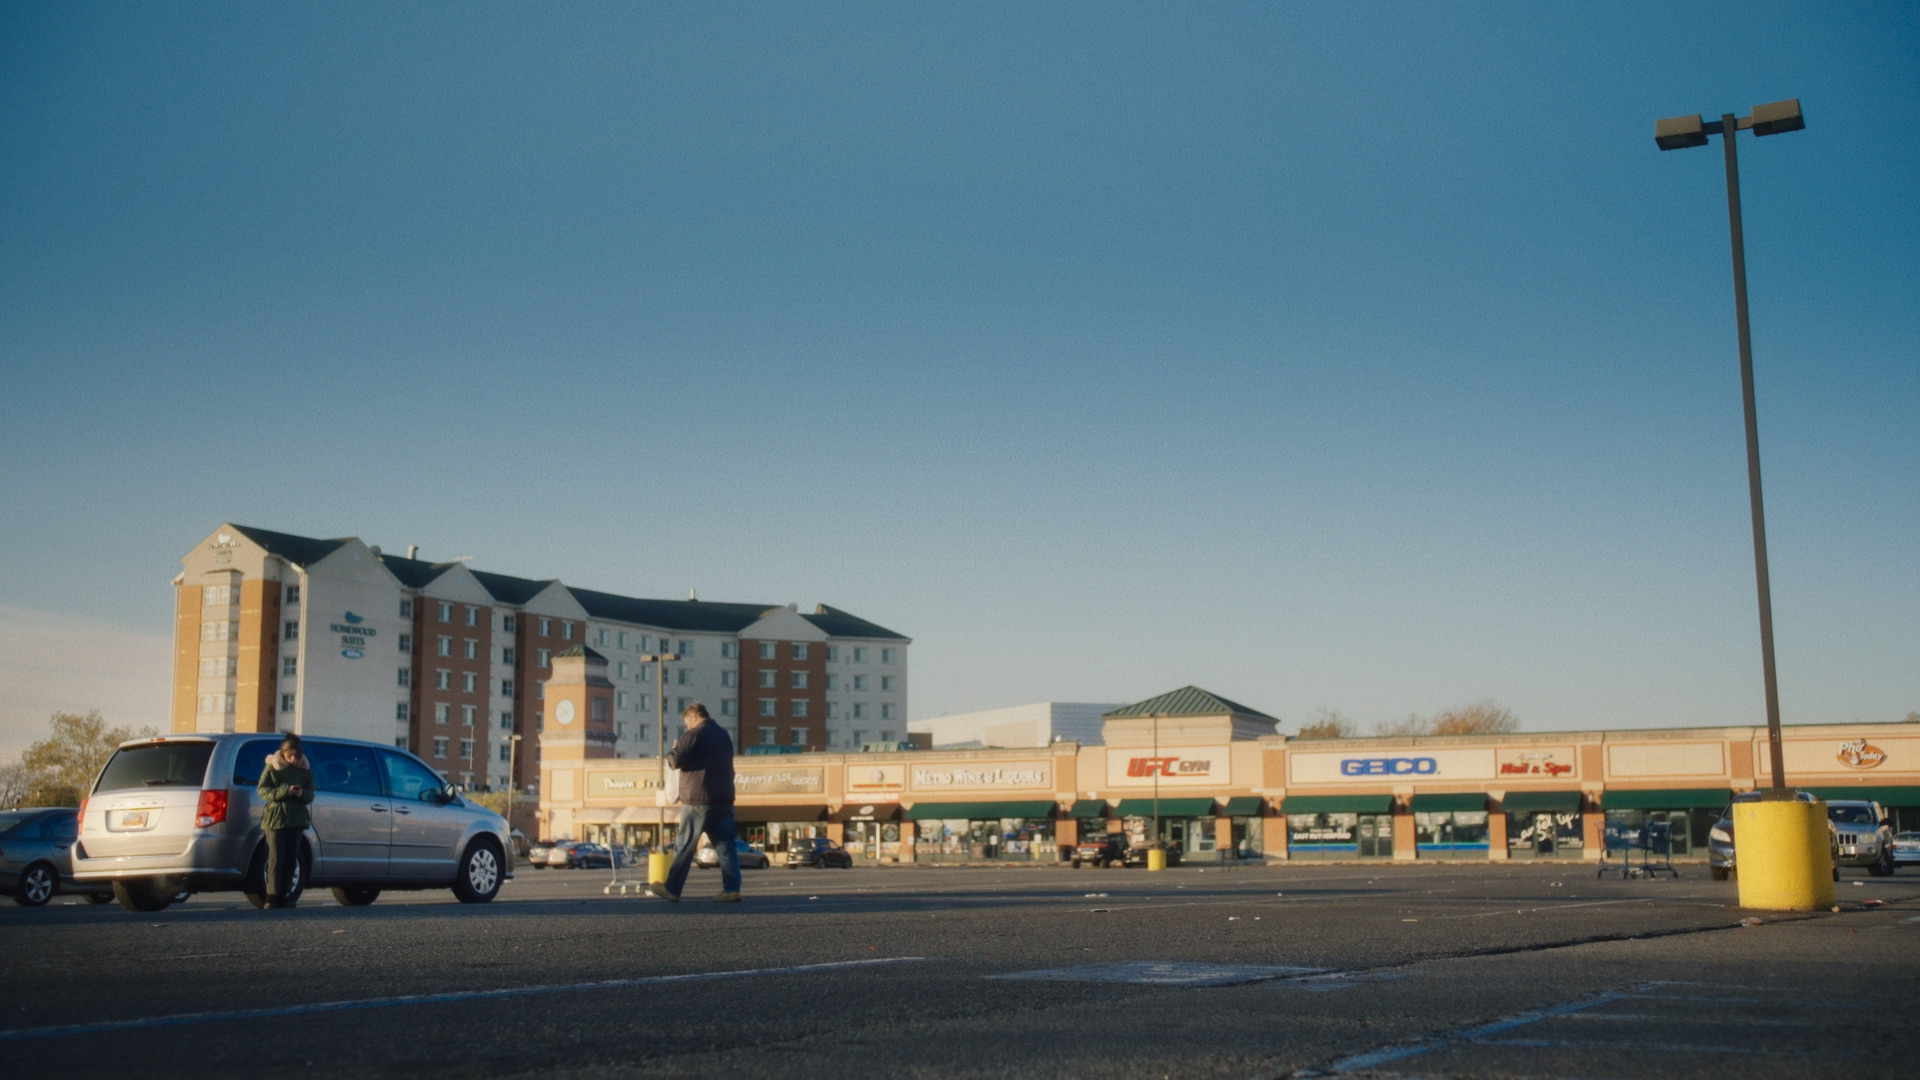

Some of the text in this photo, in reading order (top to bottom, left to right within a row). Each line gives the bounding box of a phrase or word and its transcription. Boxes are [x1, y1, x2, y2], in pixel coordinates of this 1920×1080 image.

[330, 623, 376, 637] HOMEWOOD
[1860, 752, 1884, 762] Today
[1127, 757, 1180, 777] UFC
[1340, 757, 1437, 776] GEICO
[1500, 763, 1529, 774] Nail
[1543, 762, 1571, 777] Spa
